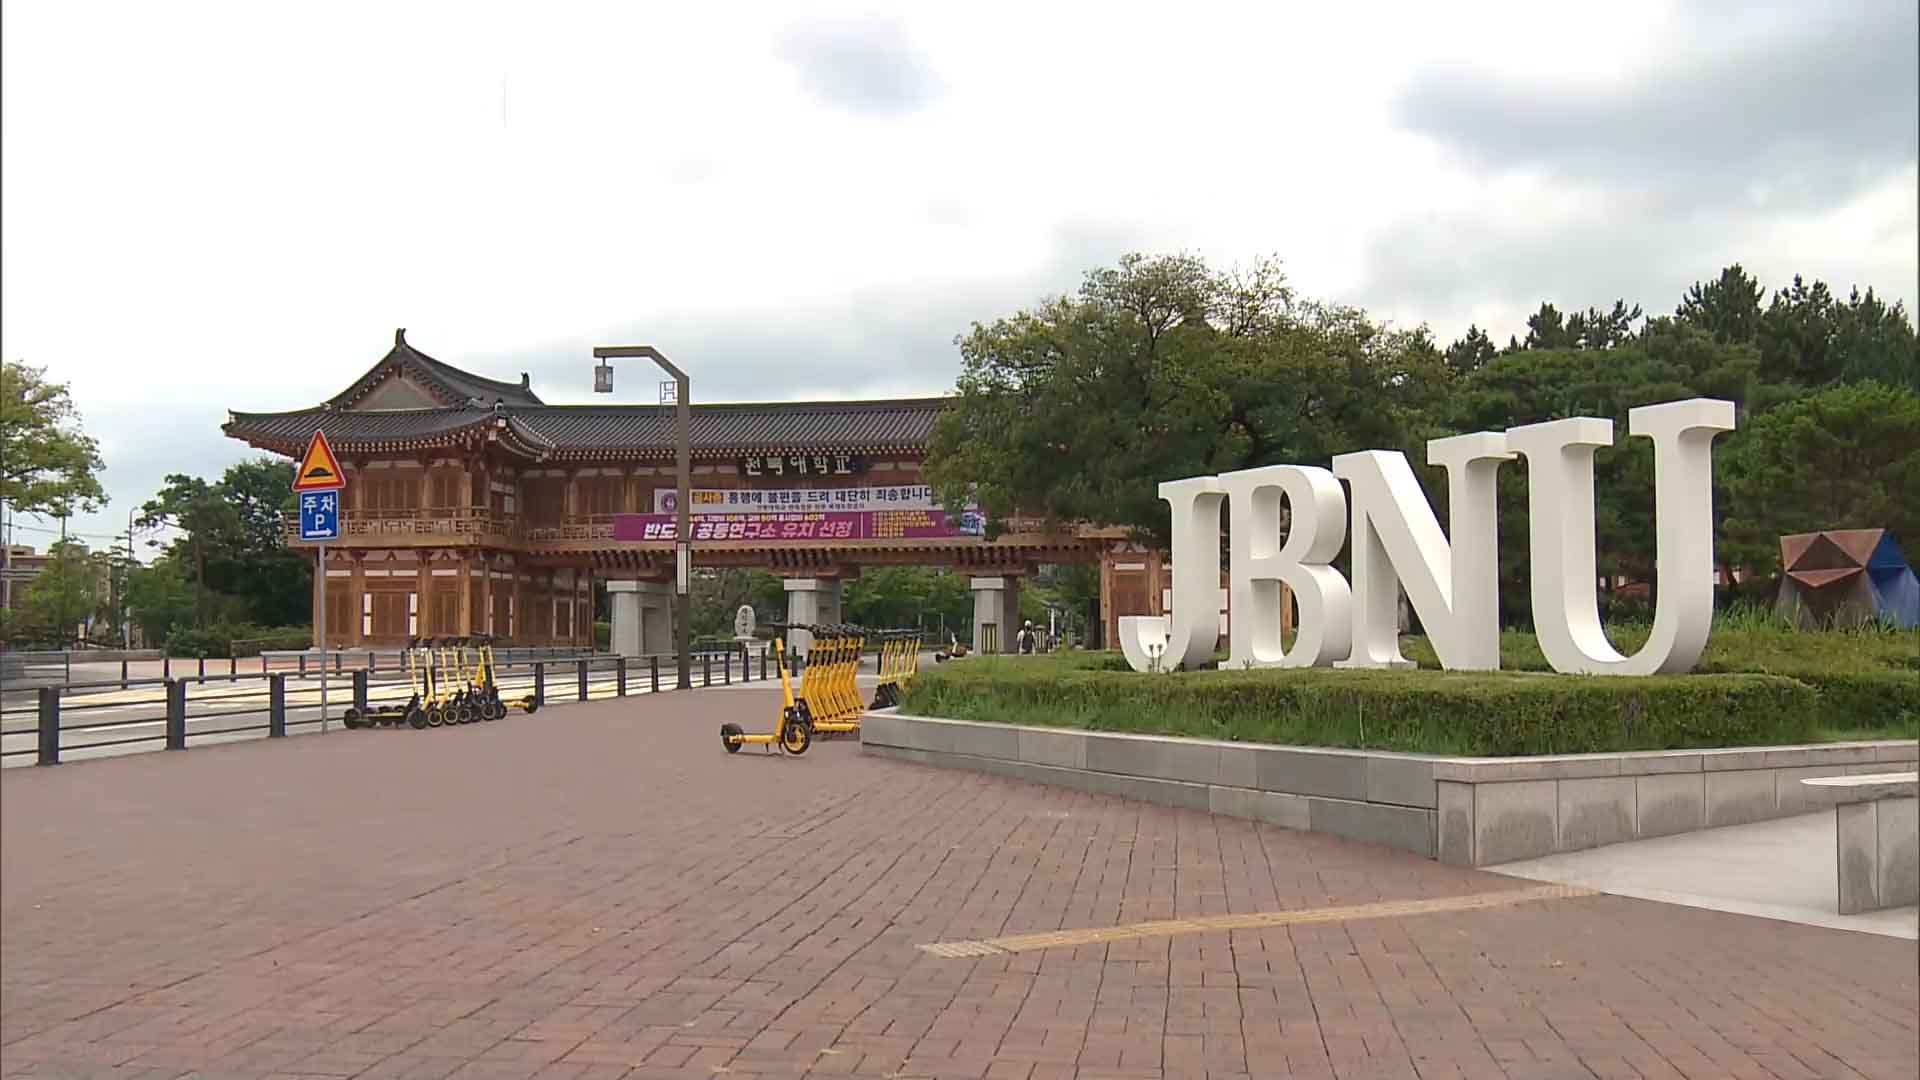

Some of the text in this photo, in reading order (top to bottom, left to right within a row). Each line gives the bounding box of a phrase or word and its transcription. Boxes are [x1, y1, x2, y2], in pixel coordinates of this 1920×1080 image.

[303, 495, 335, 514] 주차
[728, 491, 763, 504] 통행에
[768, 490, 802, 504] 불편을
[807, 490, 830, 503] 드려
[835, 489, 870, 502] 대단히
[315, 514, 325, 530] P
[696, 522, 777, 540] 공동연구소
[781, 522, 815, 538] 유치
[819, 520, 853, 538] 선정
[1118, 398, 1736, 675] JBNU
